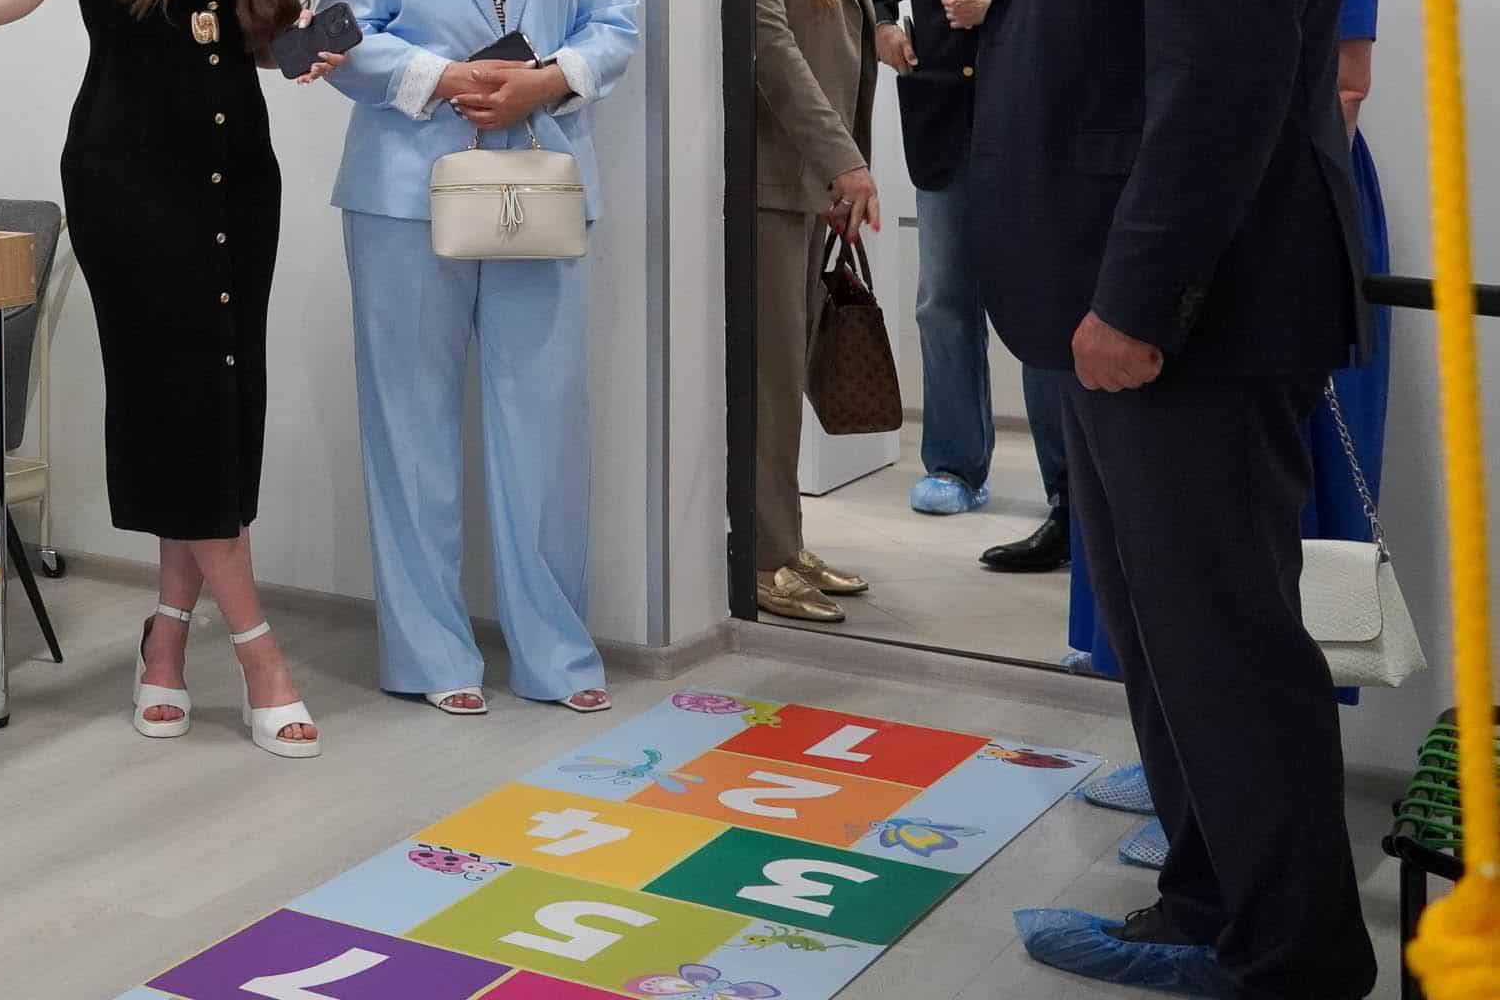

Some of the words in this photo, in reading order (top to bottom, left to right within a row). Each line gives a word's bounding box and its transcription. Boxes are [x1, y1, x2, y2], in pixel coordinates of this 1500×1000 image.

[803, 724, 877, 762] 1
[718, 770, 841, 818] 2
[525, 808, 632, 856] 4
[736, 858, 878, 917] 3
[499, 901, 658, 961] 5
[238, 947, 390, 1000] 7
